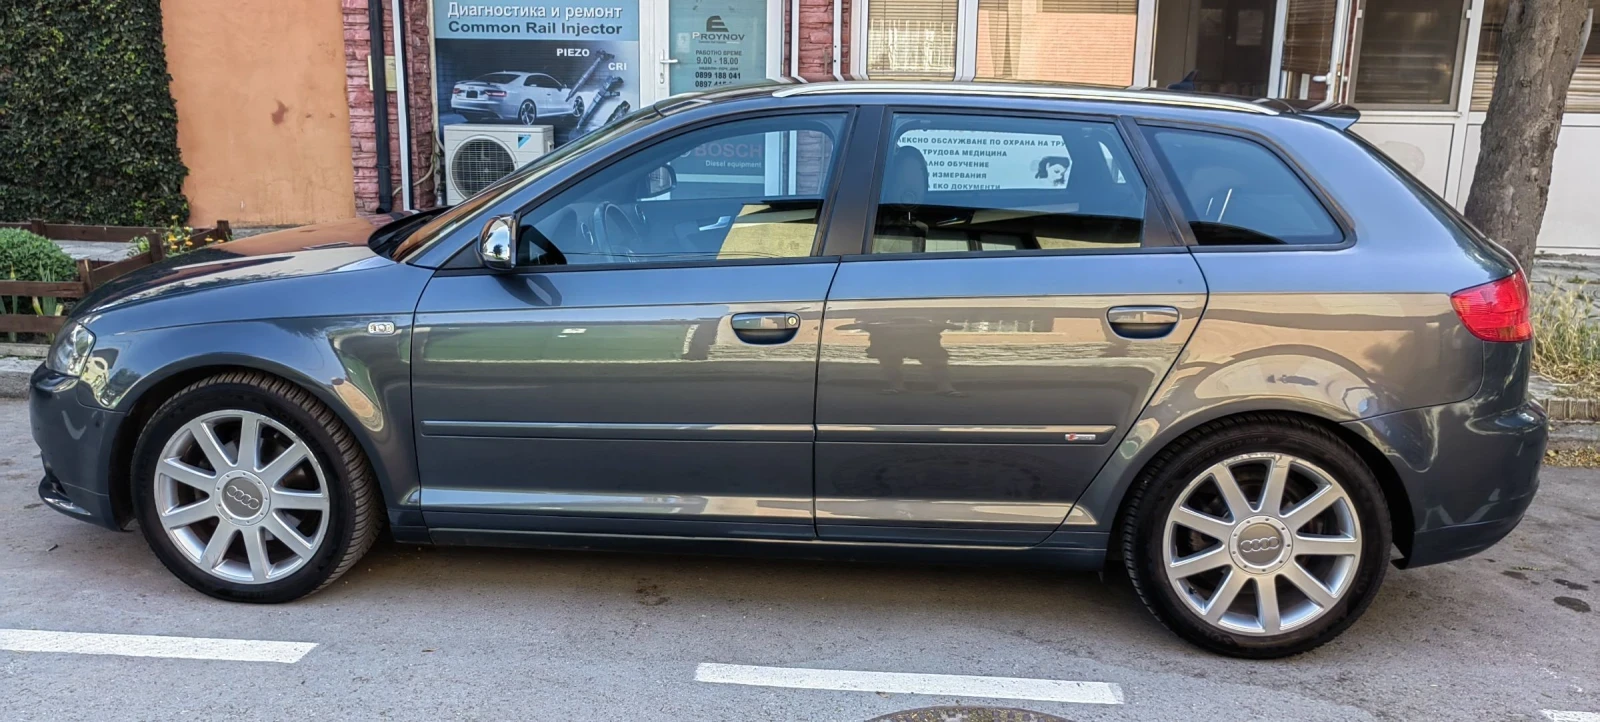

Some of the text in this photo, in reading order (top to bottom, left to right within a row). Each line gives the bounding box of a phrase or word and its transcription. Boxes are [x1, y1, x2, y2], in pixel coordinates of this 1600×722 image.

[448, 2, 623, 21] Диагностика и ремонт
[448, 21, 623, 37] Common Rail Injector
[692, 32, 746, 41] PROYNOV
[556, 48, 591, 57] PIEZO
[696, 56, 712, 64] 9.00
[719, 57, 739, 65] 18.00
[608, 62, 627, 71] CRI
[695, 71, 712, 79] 0899
[728, 72, 741, 80] 041
[695, 80, 712, 88] 0897
[931, 137, 987, 145] ОБСЛУЖВАНЕ
[990, 138, 1001, 146] ПО
[695, 143, 764, 158] BOSCH
[727, 160, 762, 168] equipment
